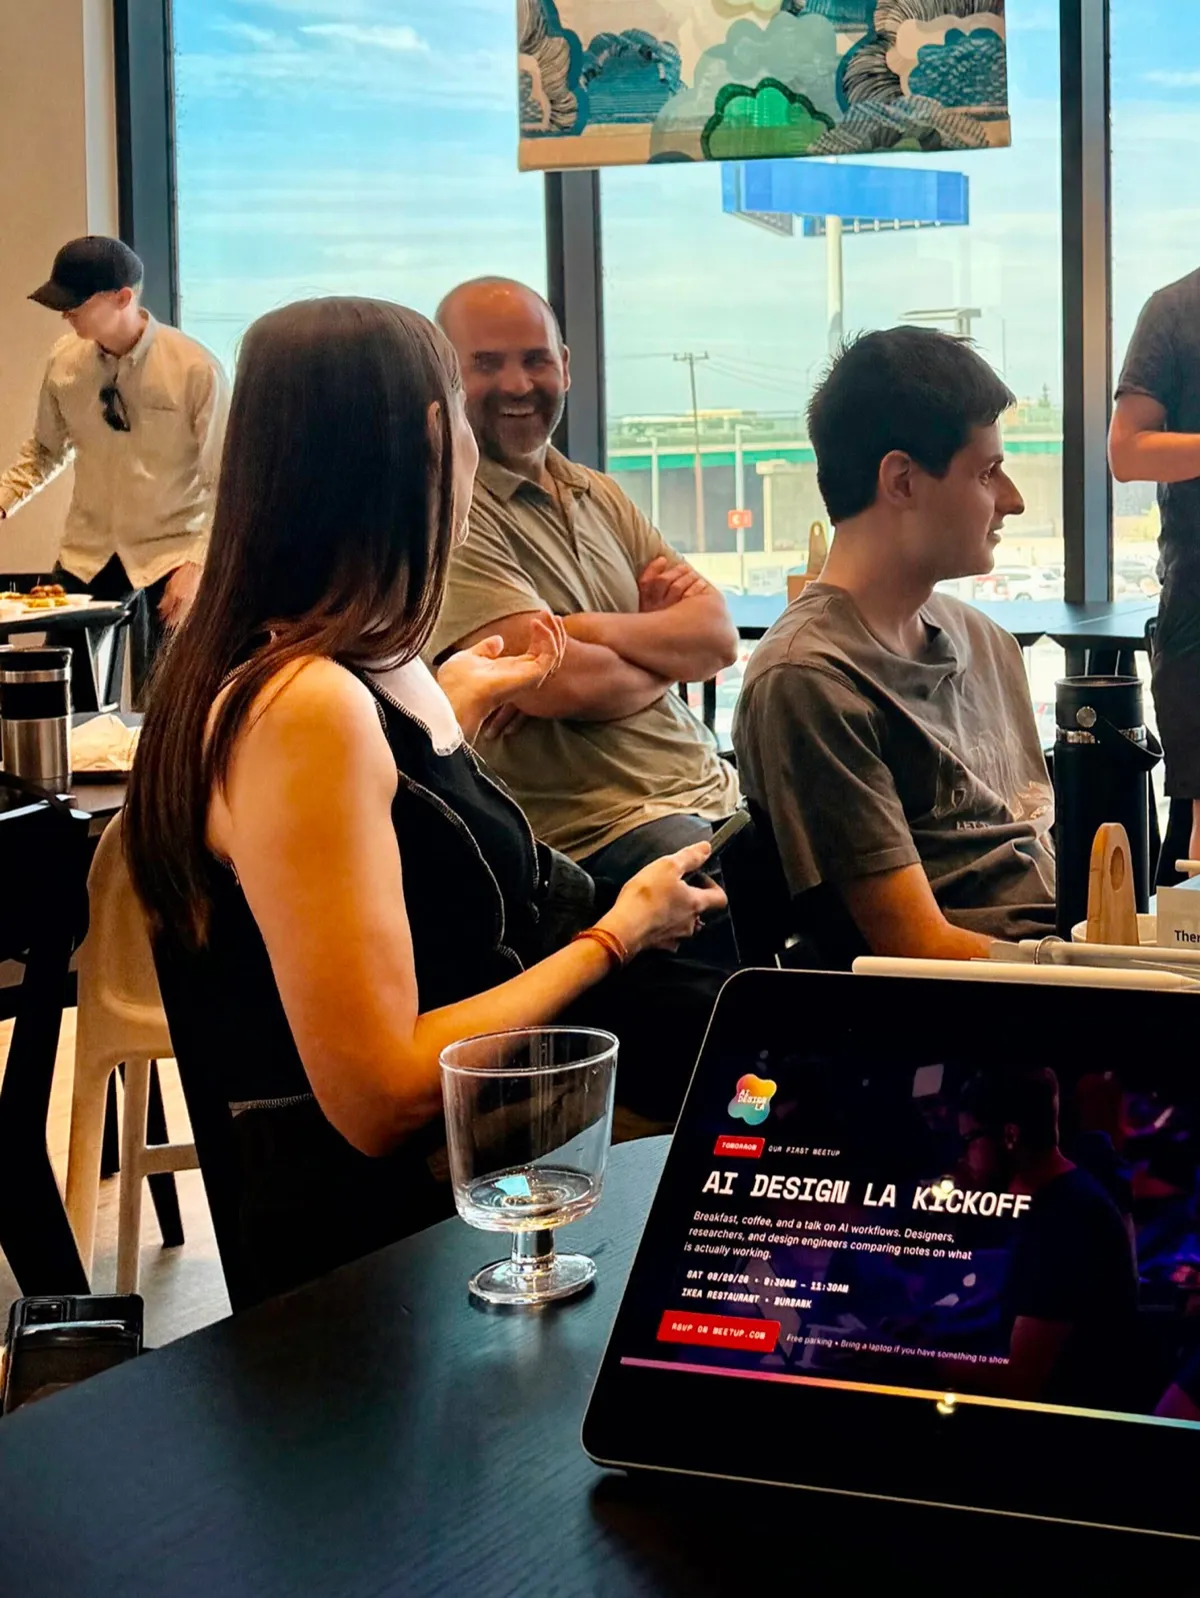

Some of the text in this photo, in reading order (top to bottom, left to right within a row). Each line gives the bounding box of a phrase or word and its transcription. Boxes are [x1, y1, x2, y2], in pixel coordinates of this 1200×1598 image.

[721, 1141, 758, 1152] TOMORROW
[768, 1144, 841, 1157] OUR FIRST MEETUP
[702, 1170, 1032, 1219] AI DESIGN LA KICKOFF
[693, 1210, 955, 1243] Breakfast, coffee, and a talk on AI workflows. Designers,
[684, 1241, 772, 1261] is actually working.
[688, 1226, 972, 1260] researchers, and design engineers comparing notes on what
[686, 1270, 703, 1280] SAT
[810, 1281, 849, 1293] 11:30AM
[681, 1287, 813, 1309] IKEA RESTAURANT BURBANK
[672, 1322, 766, 1341] RSVP ON MEETUP.COM
[786, 1333, 803, 1343] Free
[804, 1336, 832, 1348] parking
[840, 1339, 861, 1351] Bring
[868, 1342, 893, 1354] laptop
[894, 1344, 900, 1354] if
[901, 1346, 916, 1357] you
[917, 1348, 936, 1358] have
[937, 1350, 977, 1363] something
[979, 1354, 987, 1363] to
[988, 1356, 1010, 1366] show
